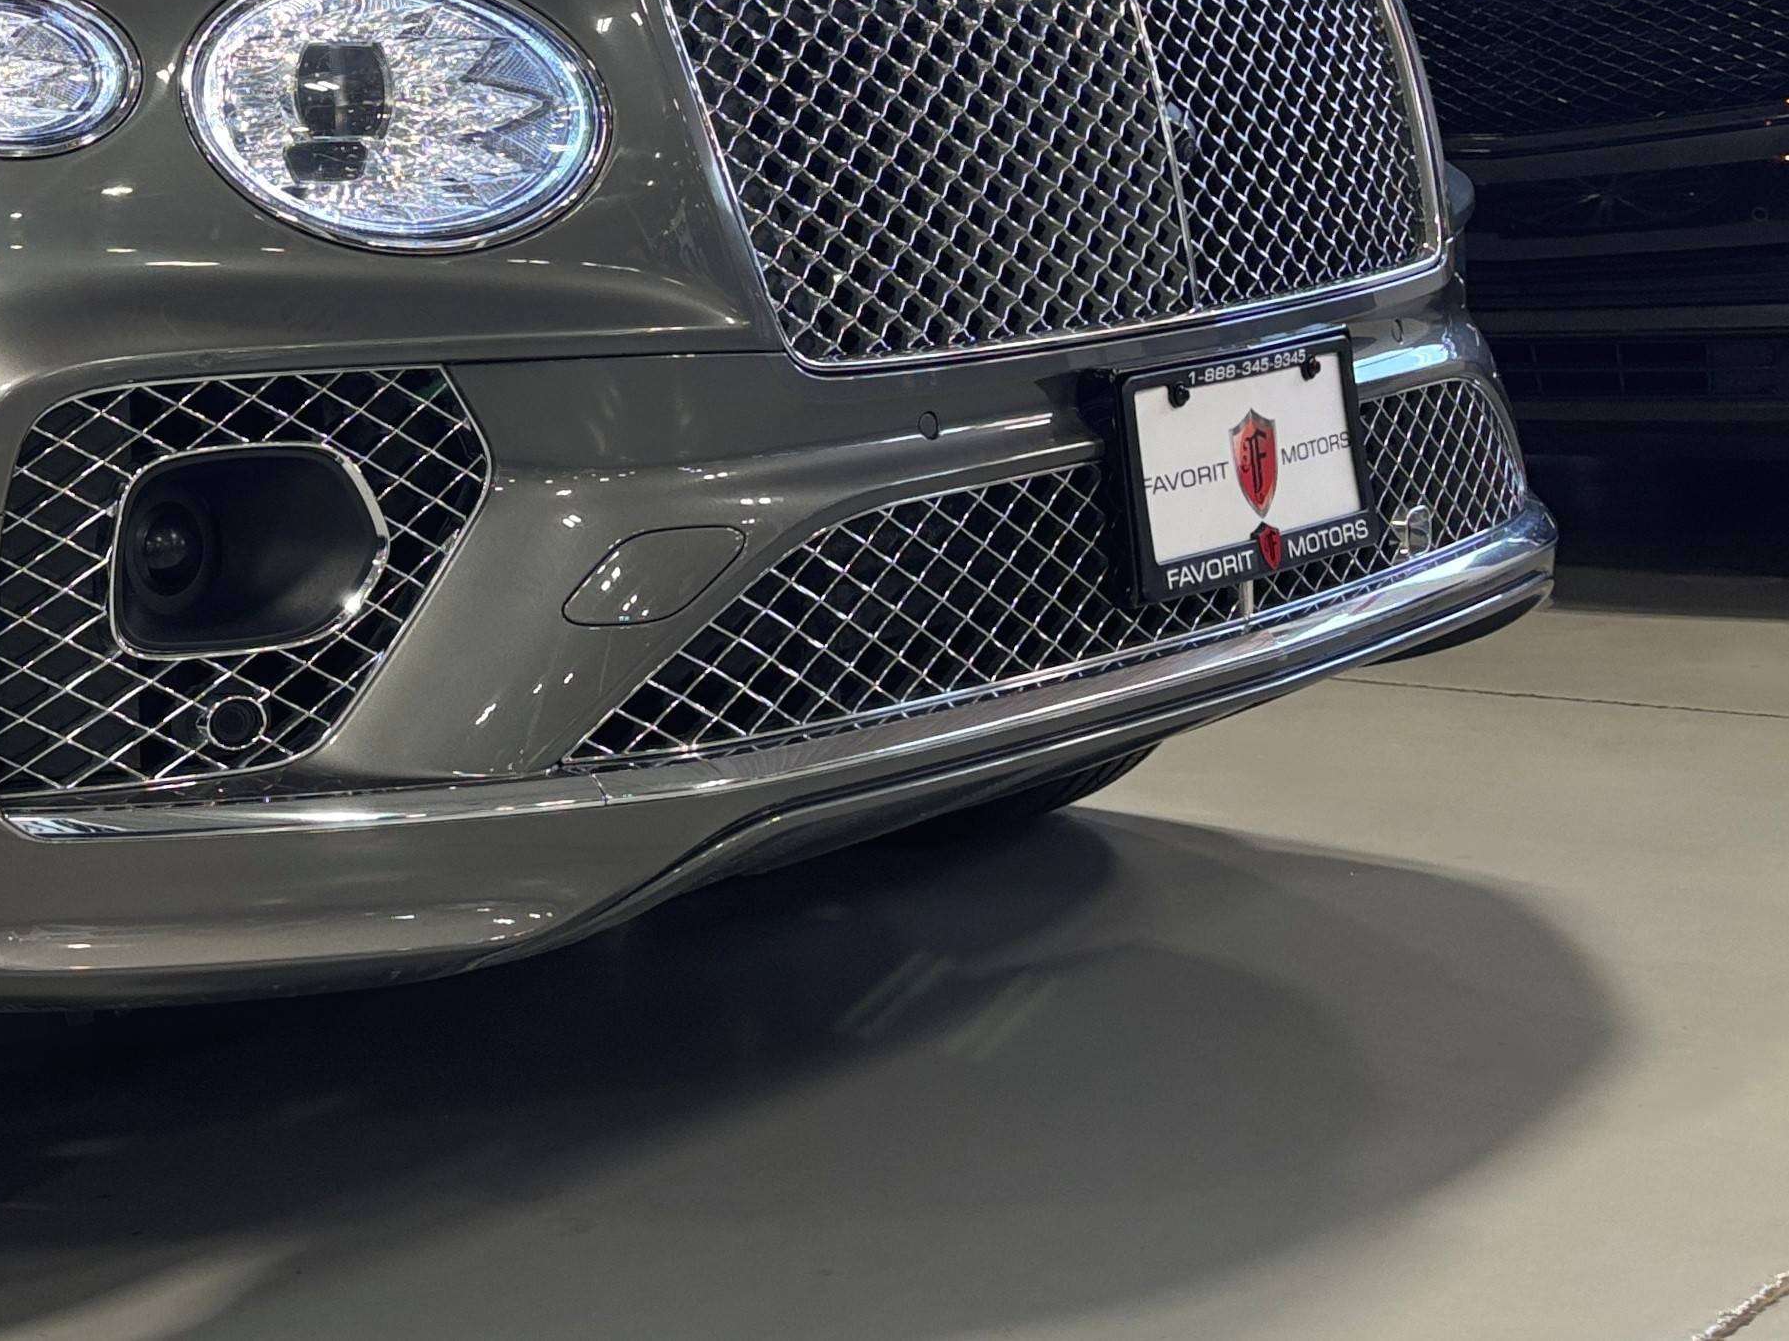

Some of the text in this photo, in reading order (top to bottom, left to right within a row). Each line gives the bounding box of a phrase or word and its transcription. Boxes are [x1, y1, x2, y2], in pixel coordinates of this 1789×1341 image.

[1188, 349, 1306, 385] 1-888-345-9345
[1281, 431, 1351, 465] MOTORS
[1167, 519, 1369, 590] FAVORIT MOTORS
